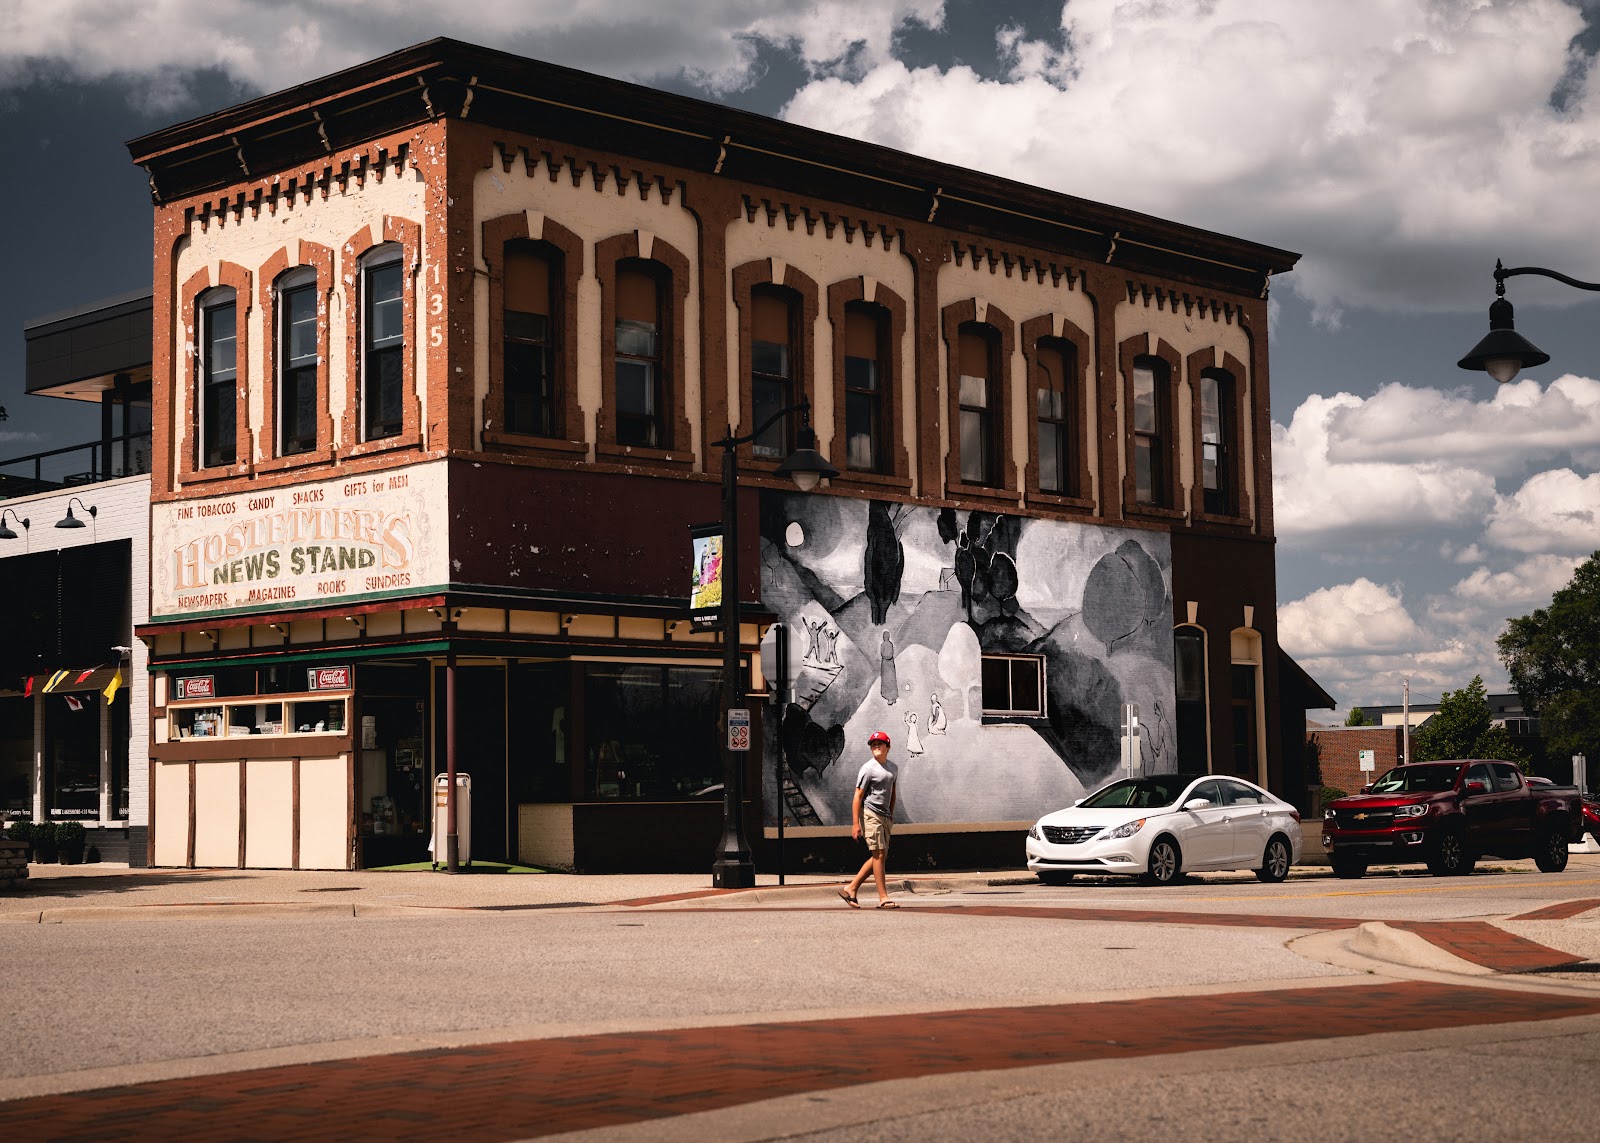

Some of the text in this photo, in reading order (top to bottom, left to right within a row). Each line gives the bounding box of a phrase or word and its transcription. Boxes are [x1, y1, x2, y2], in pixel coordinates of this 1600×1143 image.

[431, 261, 443, 347] 135
[177, 474, 409, 520] FINE TOBACCOS CANDY SNACKS GIFTS for MEN
[173, 506, 414, 591] HOSTETTER'S
[213, 546, 376, 584] NEWS STAND
[178, 572, 411, 608] NEWSPAPERS MAGAZINES BOOKS SUNDRIES
